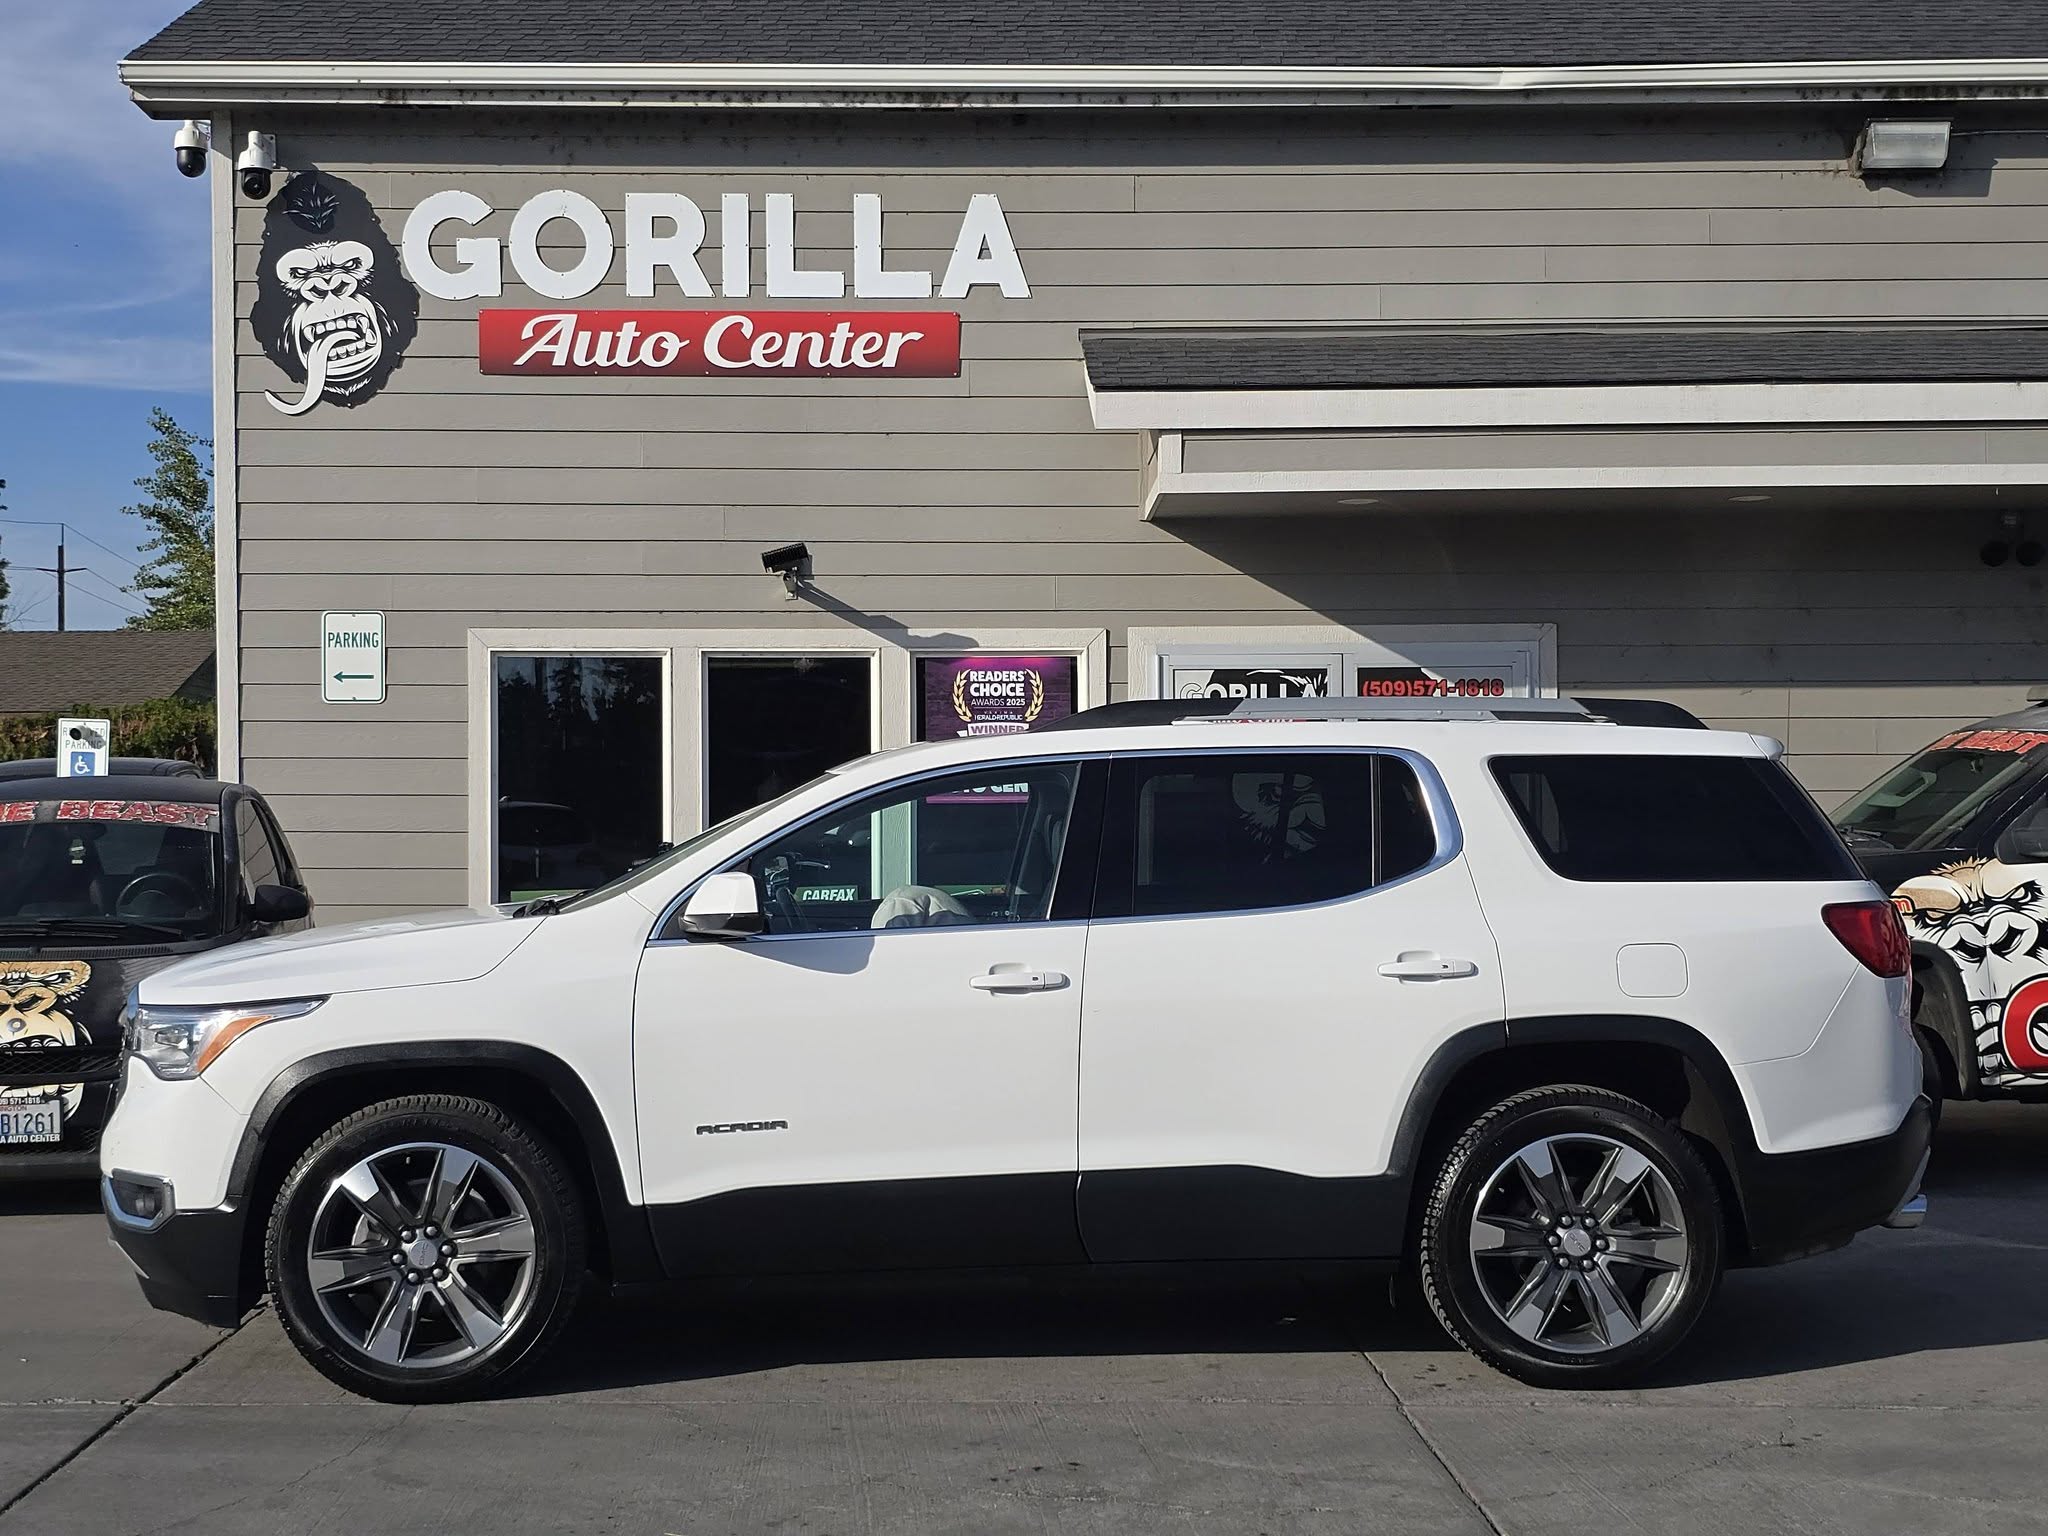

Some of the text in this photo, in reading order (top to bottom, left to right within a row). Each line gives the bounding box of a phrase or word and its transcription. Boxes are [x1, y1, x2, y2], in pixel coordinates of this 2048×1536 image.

[402, 189, 1032, 300] GORILLA
[513, 313, 925, 369] Auto Center
[328, 632, 379, 648] PARKING
[970, 670, 1028, 682] READERS'
[970, 682, 1025, 697] CHOICE
[1362, 679, 1504, 697] (509)571-1818
[970, 698, 1026, 706] AWARDS 2025
[57, 800, 219, 826] BEAST
[802, 888, 855, 901] CARFAX
[696, 1120, 788, 1135] ACADIA
[8, 1135, 28, 1143] AUTO
[30, 1134, 60, 1142] CENTER
